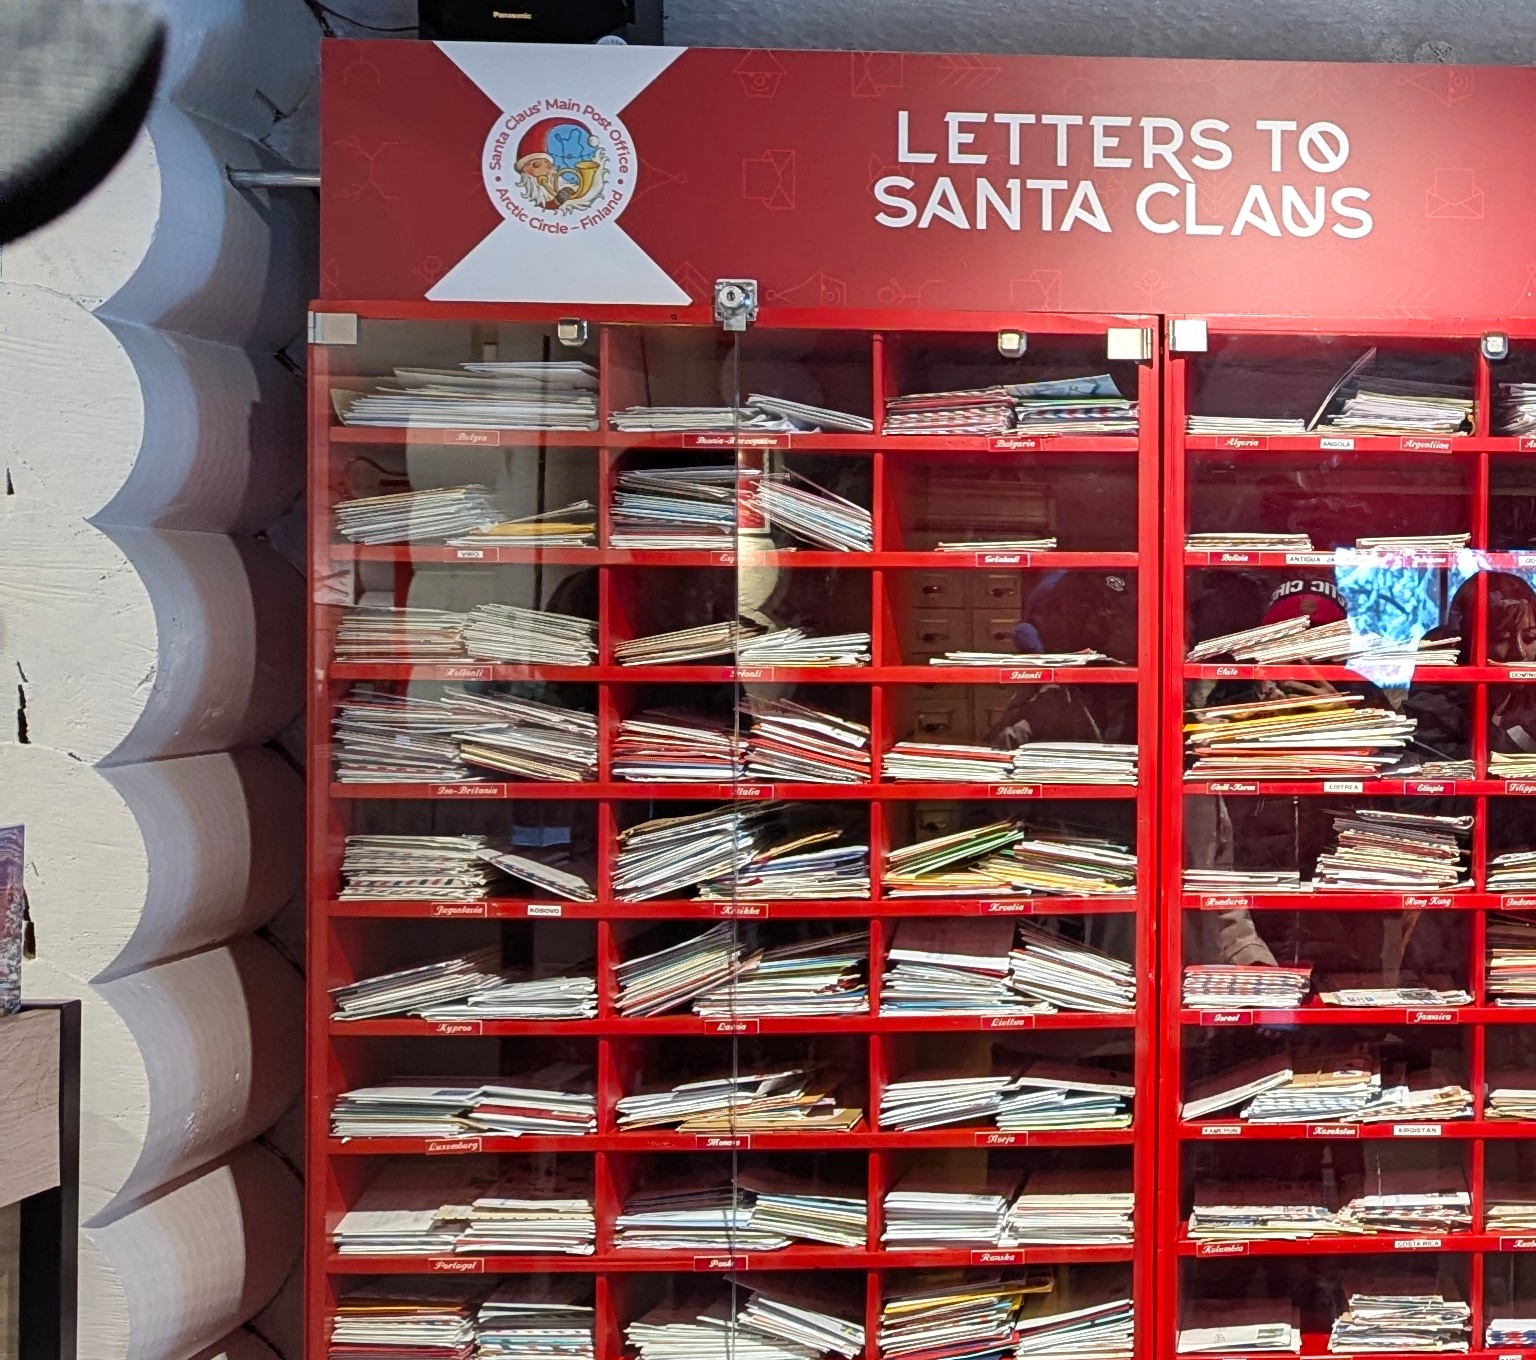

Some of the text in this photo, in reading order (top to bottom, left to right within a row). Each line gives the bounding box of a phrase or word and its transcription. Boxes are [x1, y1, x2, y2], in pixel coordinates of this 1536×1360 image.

[489, 131, 510, 170] Santa
[545, 98, 581, 112] Main
[582, 104, 612, 131] Post
[609, 129, 631, 174] Office
[896, 110, 1350, 183] LETTERS TO
[496, 187, 529, 223] Arctic
[528, 216, 569, 235] Circle
[579, 189, 624, 230] Finland
[874, 176, 1374, 239] SANTA CLAUS
[995, 439, 1036, 449] Bulgaria
[1224, 439, 1260, 449] Algeria
[528, 906, 561, 914] KOSOVO
[987, 903, 1025, 912] Kroatia
[1413, 1012, 1452, 1023] Jamaica
[435, 1023, 472, 1035] Kypros
[434, 1259, 477, 1272] Portugal
